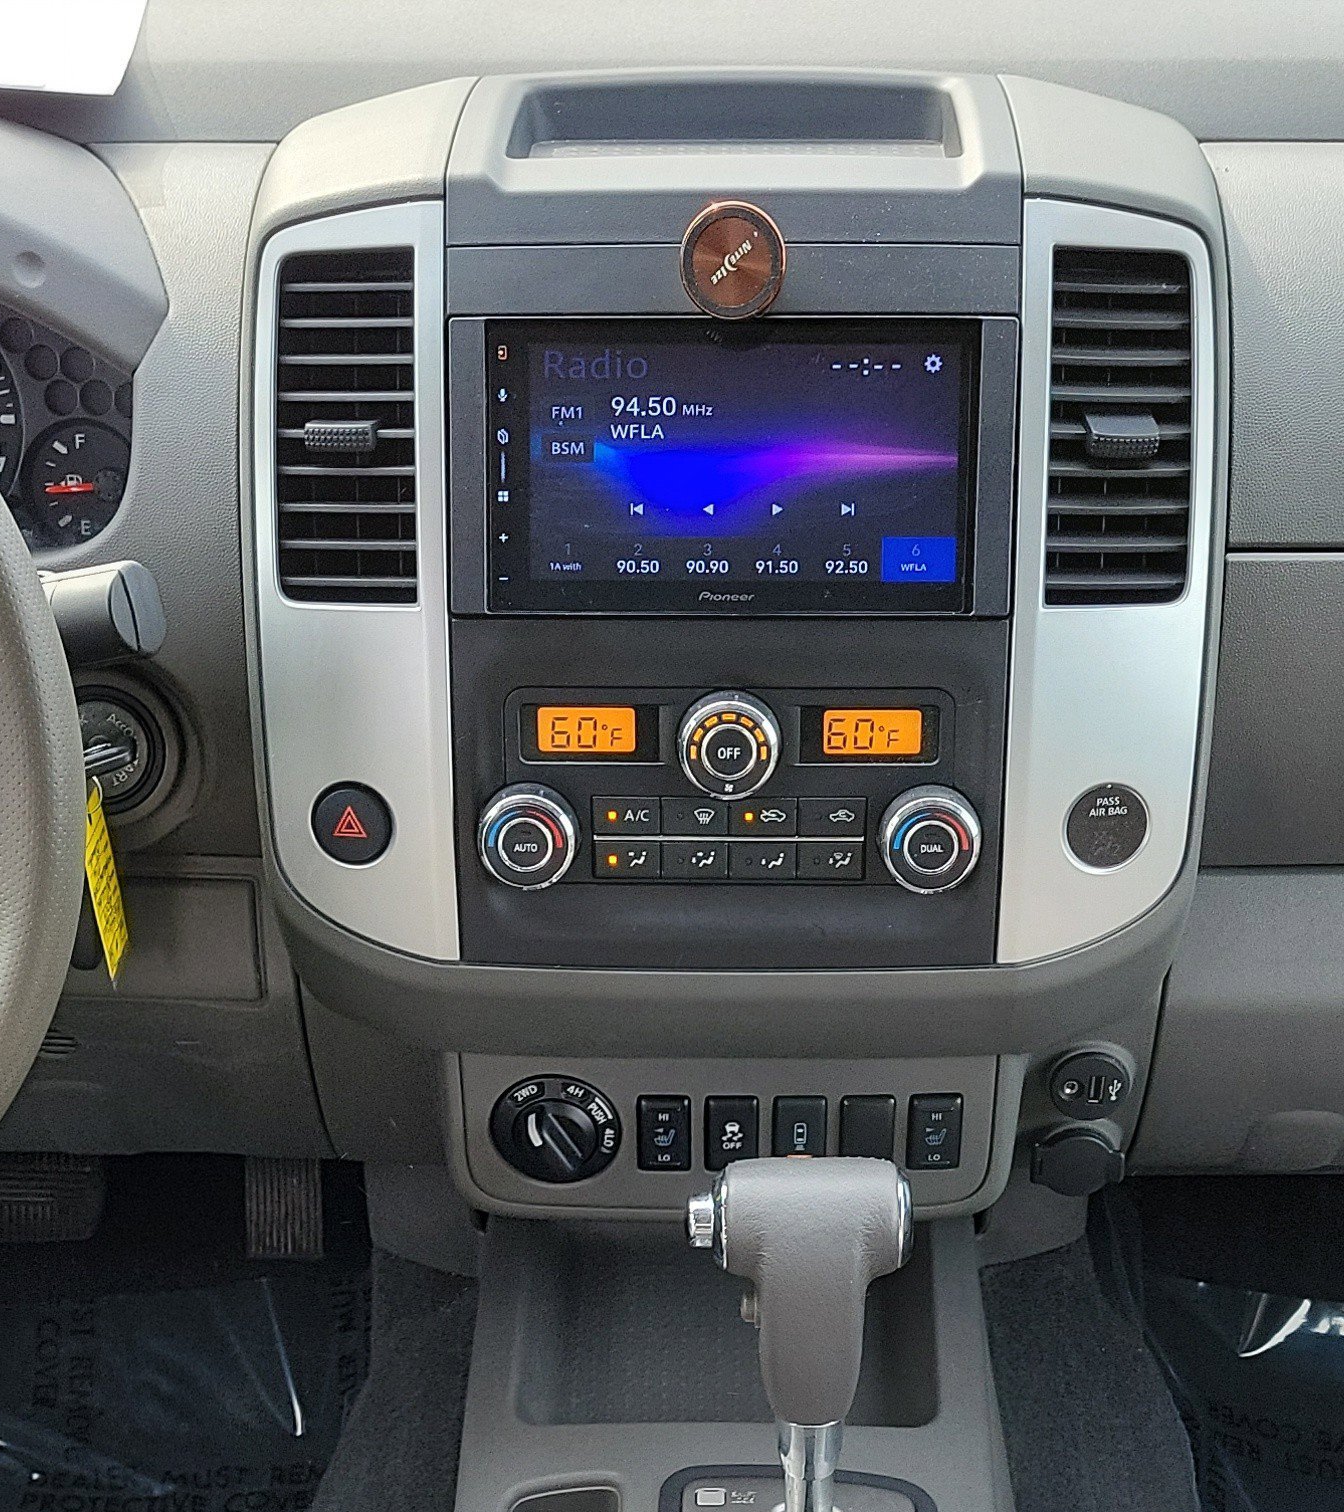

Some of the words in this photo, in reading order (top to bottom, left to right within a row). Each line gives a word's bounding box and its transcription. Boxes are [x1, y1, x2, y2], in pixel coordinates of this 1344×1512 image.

[543, 349, 649, 379] Radio
[551, 406, 583, 420] FM1
[610, 396, 677, 417] 94.50
[682, 404, 713, 416] MHz
[610, 423, 665, 440] WFLA
[75, 435, 86, 449] F
[551, 442, 585, 455] BSM
[80, 521, 92, 536] E
[564, 543, 572, 556] 1
[633, 543, 643, 556] 2
[703, 543, 712, 556] 3
[772, 543, 782, 556] 4
[842, 543, 852, 556] 5
[911, 543, 921, 556] 6
[616, 560, 659, 575] 90.50
[686, 560, 729, 575] 90.90
[755, 560, 799, 575] 91.50
[825, 560, 868, 575] 92.50
[900, 562, 927, 572] WFLA
[698, 591, 755, 602] Pioneer
[717, 748, 741, 760] OFF
[1096, 796, 1120, 807] PASS
[624, 810, 650, 822] A/C
[1089, 808, 1105, 818] AIR
[1108, 806, 1128, 816] BAG
[513, 843, 538, 852] AUTO
[920, 844, 943, 853] DUAL
[513, 1084, 538, 1101] 2WD
[567, 1085, 585, 1098] 4H
[587, 1102, 608, 1124] PUSH
[658, 1113, 669, 1122] HI
[931, 1112, 942, 1121] HI
[603, 1128, 615, 1147] 4LO
[722, 1141, 743, 1150] OFF
[658, 1154, 671, 1162] LO
[928, 1153, 941, 1162] LO
